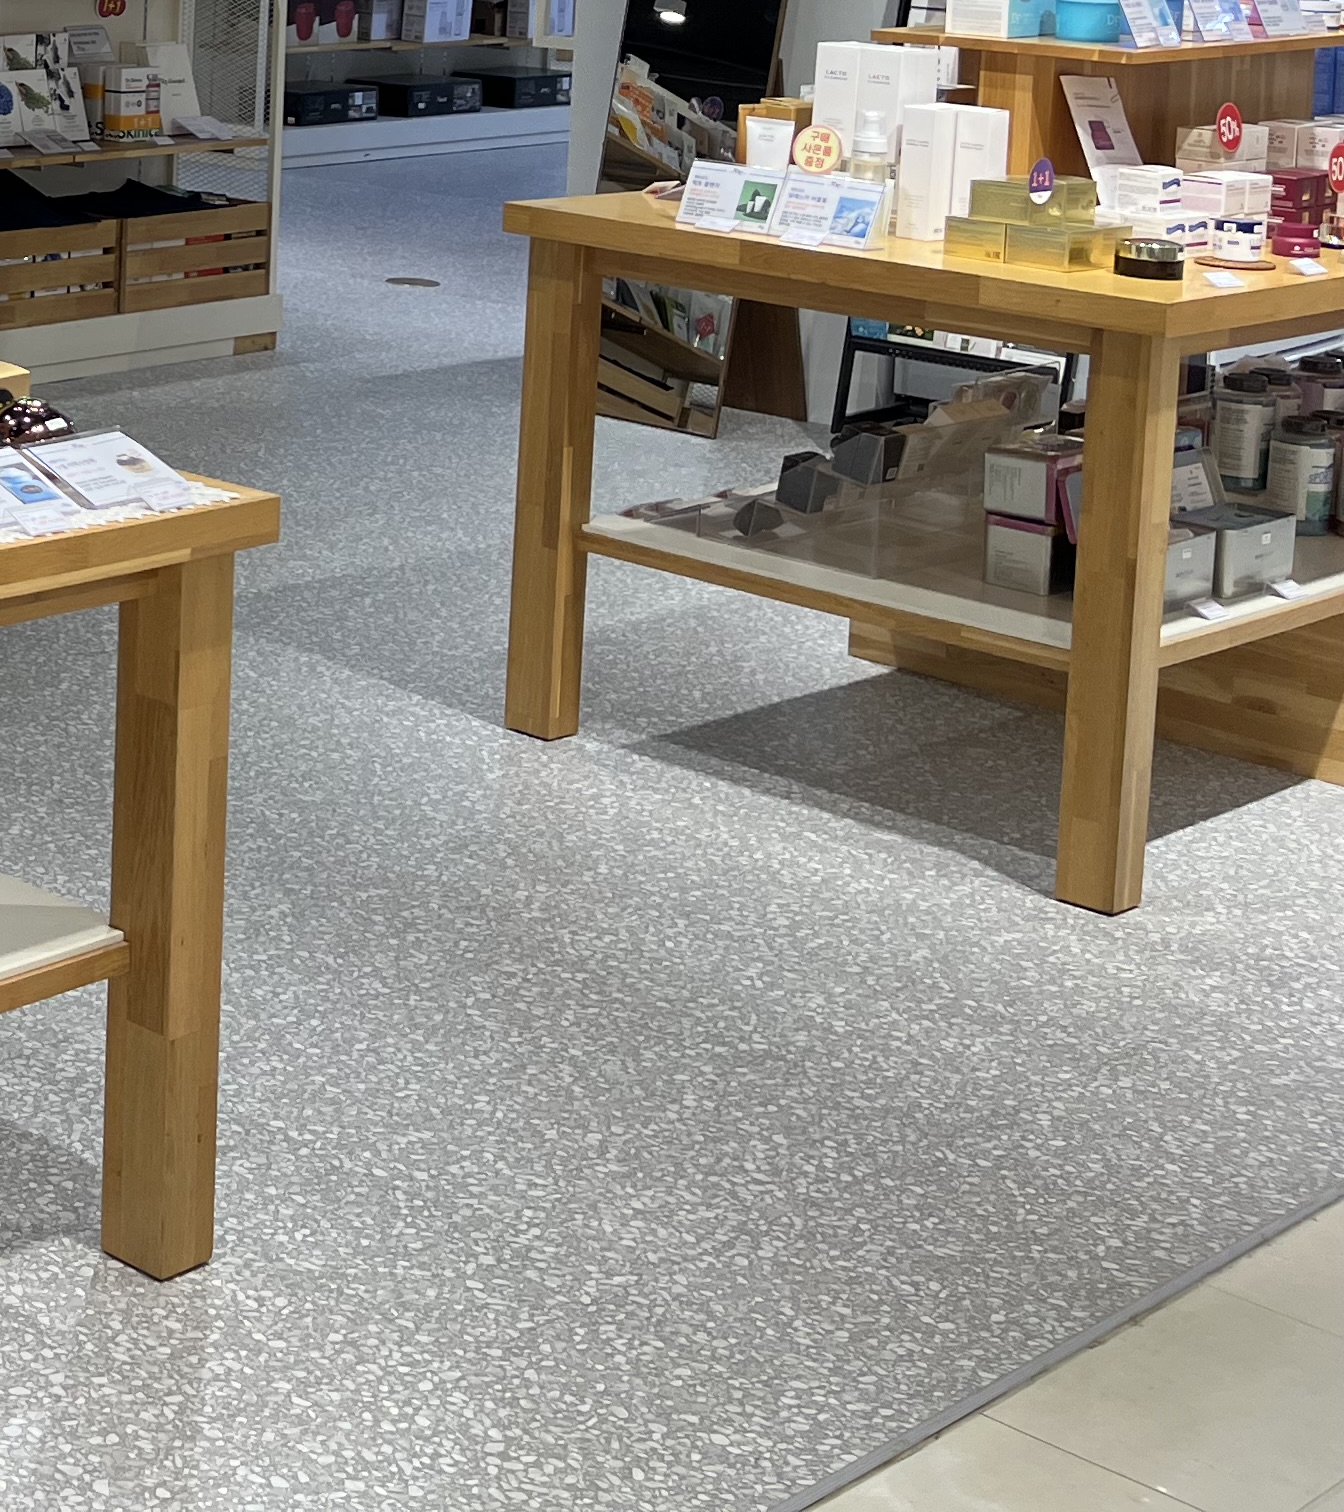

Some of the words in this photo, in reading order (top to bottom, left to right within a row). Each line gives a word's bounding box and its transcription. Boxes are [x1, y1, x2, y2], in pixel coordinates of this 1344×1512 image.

[1220, 116, 1240, 142] 50%
[810, 131, 830, 143] 구매
[801, 143, 832, 157] 사은품
[804, 156, 824, 168] 증정
[1032, 171, 1050, 186] 1+1
